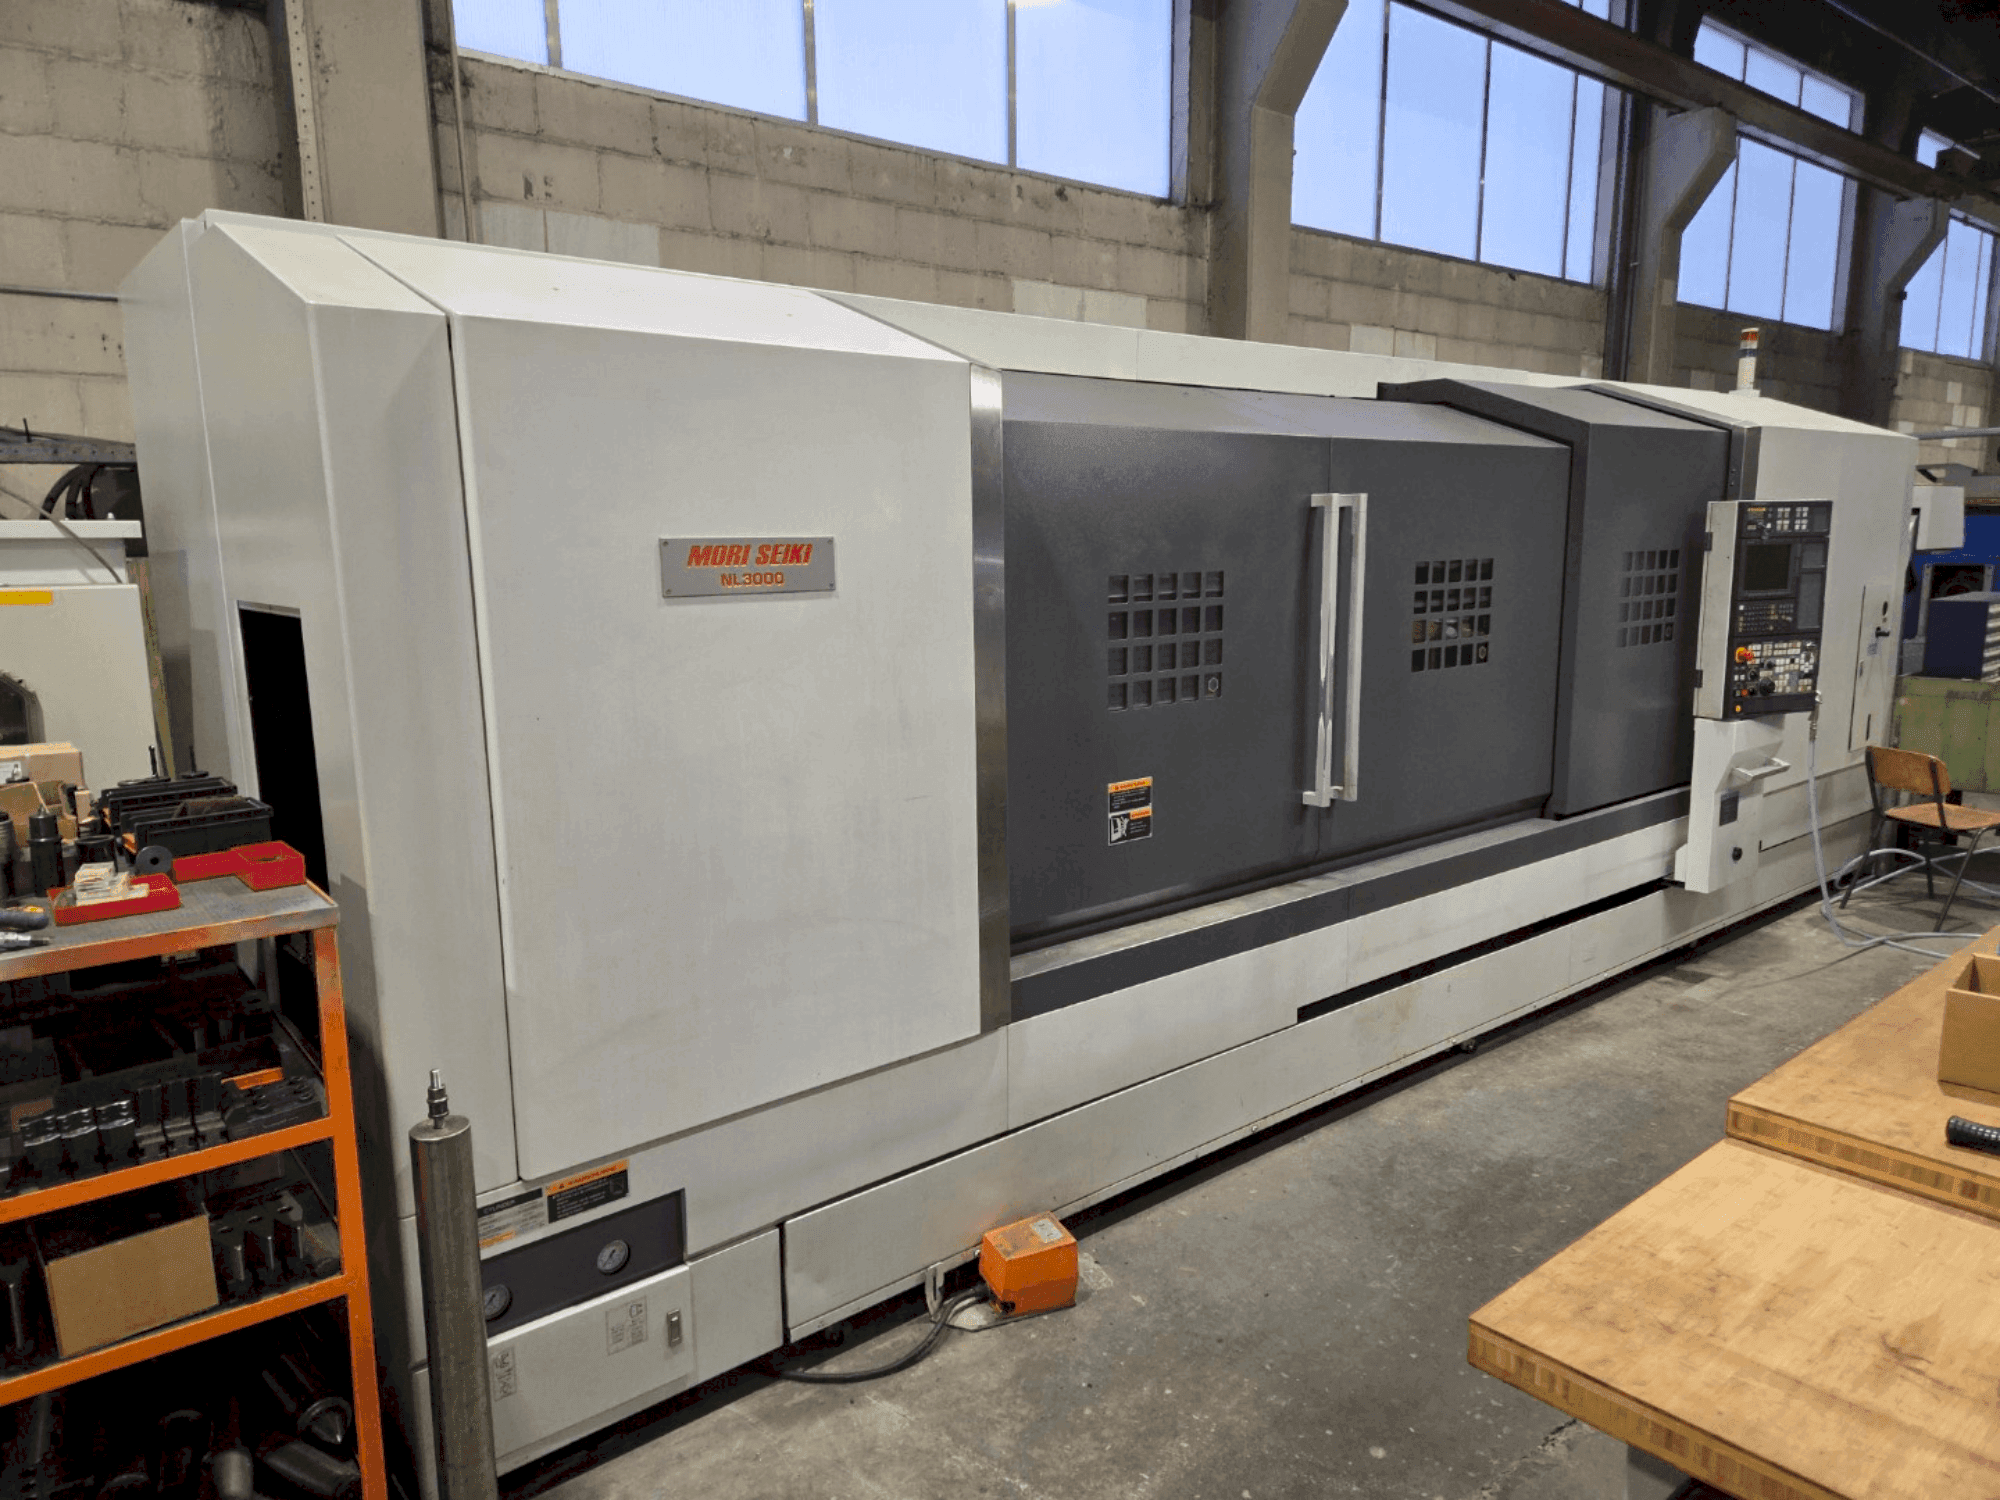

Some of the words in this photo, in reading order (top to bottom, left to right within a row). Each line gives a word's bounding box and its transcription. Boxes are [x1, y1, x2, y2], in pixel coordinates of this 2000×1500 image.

[687, 544, 751, 566] MORI
[756, 543, 813, 565] SEIKI
[720, 572, 784, 587] NL3000
